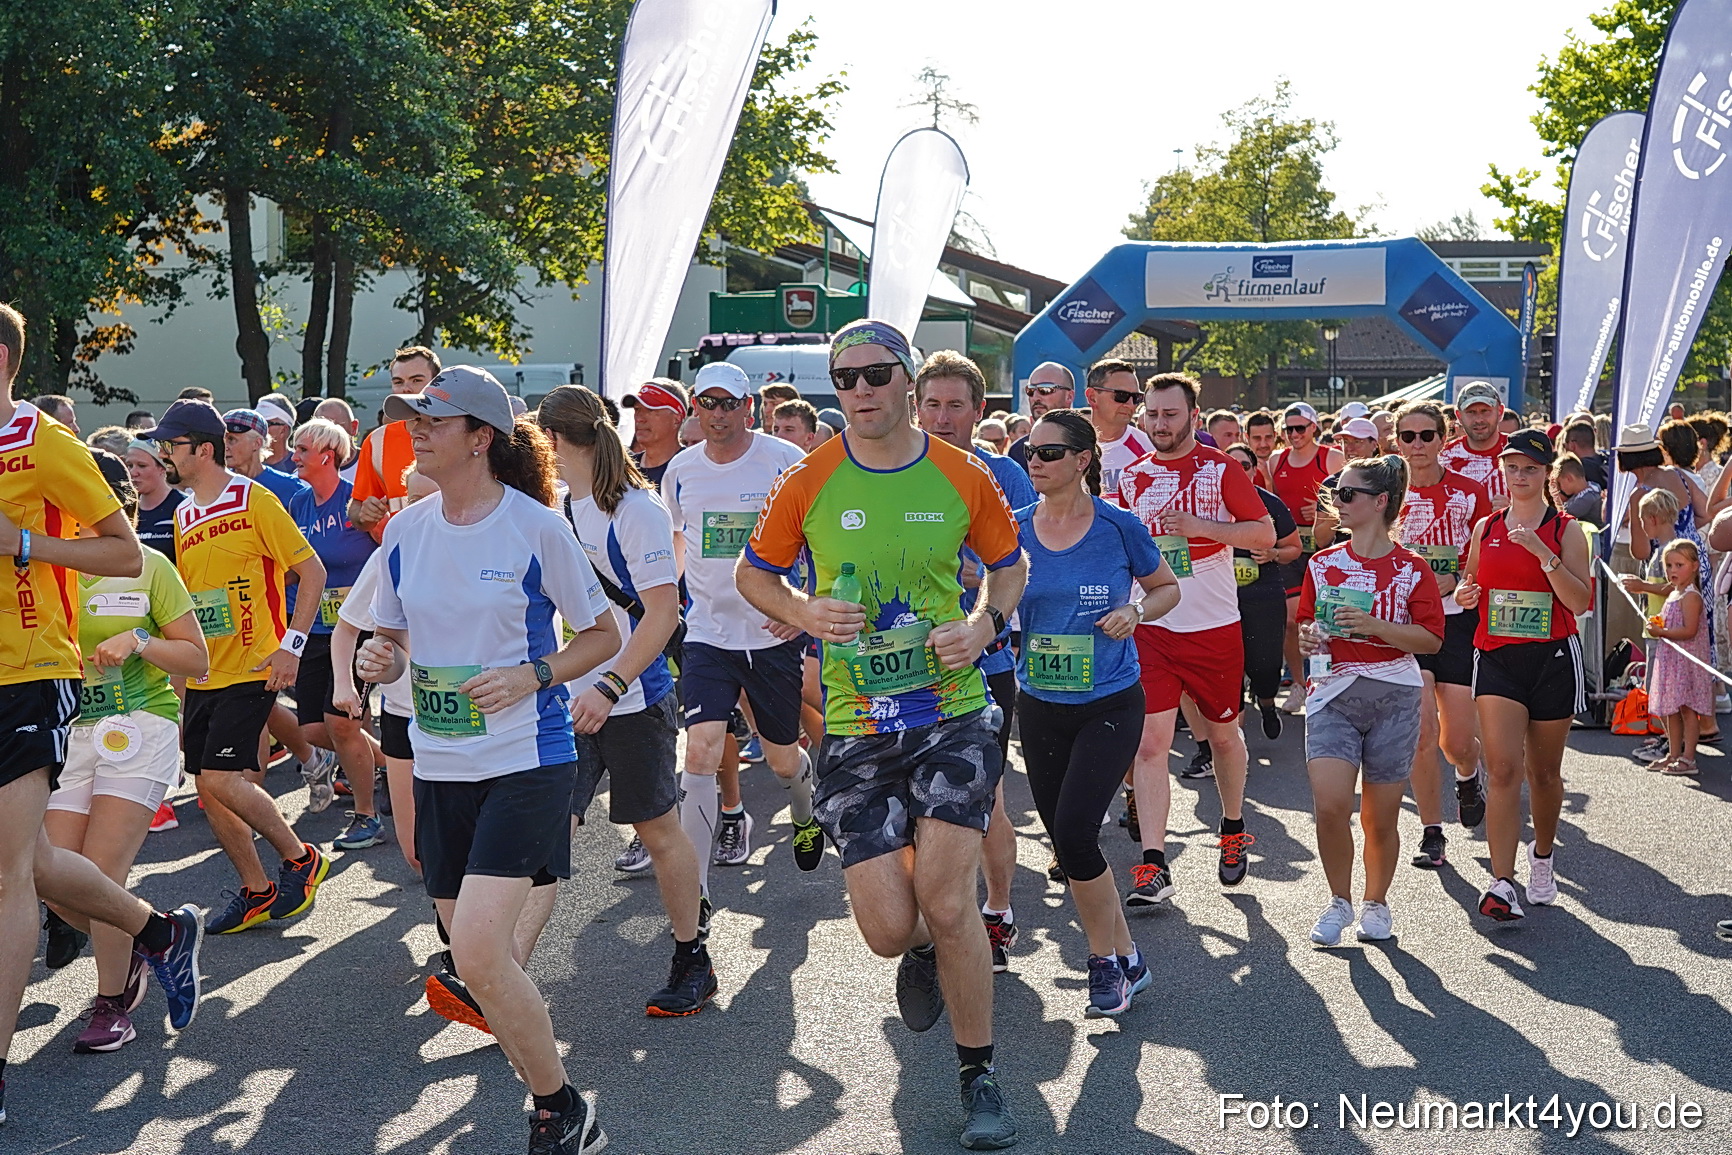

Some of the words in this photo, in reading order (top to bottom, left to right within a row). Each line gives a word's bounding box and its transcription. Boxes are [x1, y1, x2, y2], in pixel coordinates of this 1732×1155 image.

[1594, 137, 1641, 242] Fischer
[1238, 277, 1327, 295] firmenlauf
[1064, 304, 1115, 319] Fischer
[904, 512, 945, 522] BOCK
[181, 530, 205, 551] MAX
[208, 518, 253, 539] BÖGL
[715, 528, 747, 544] 317
[1181, 550, 1190, 572] 2022
[1079, 585, 1110, 595] DESS
[221, 606, 232, 628] 2022
[1498, 606, 1541, 623] 1172
[1541, 611, 1549, 632] 2022
[869, 648, 914, 676] 607
[924, 646, 937, 676] 2022
[1038, 653, 1072, 673] 141
[1082, 657, 1090, 683] 2022
[853, 664, 865, 686] RUN
[863, 676, 893, 686] Taucher
[894, 667, 929, 681] Jonathan
[1035, 672, 1054, 680] Urban
[1055, 673, 1079, 681] Marion
[112, 684, 125, 711] 2022
[419, 688, 459, 715] 305
[91, 704, 116, 713] Leonie
[469, 697, 481, 727] 202
[440, 716, 471, 724] Melanie
